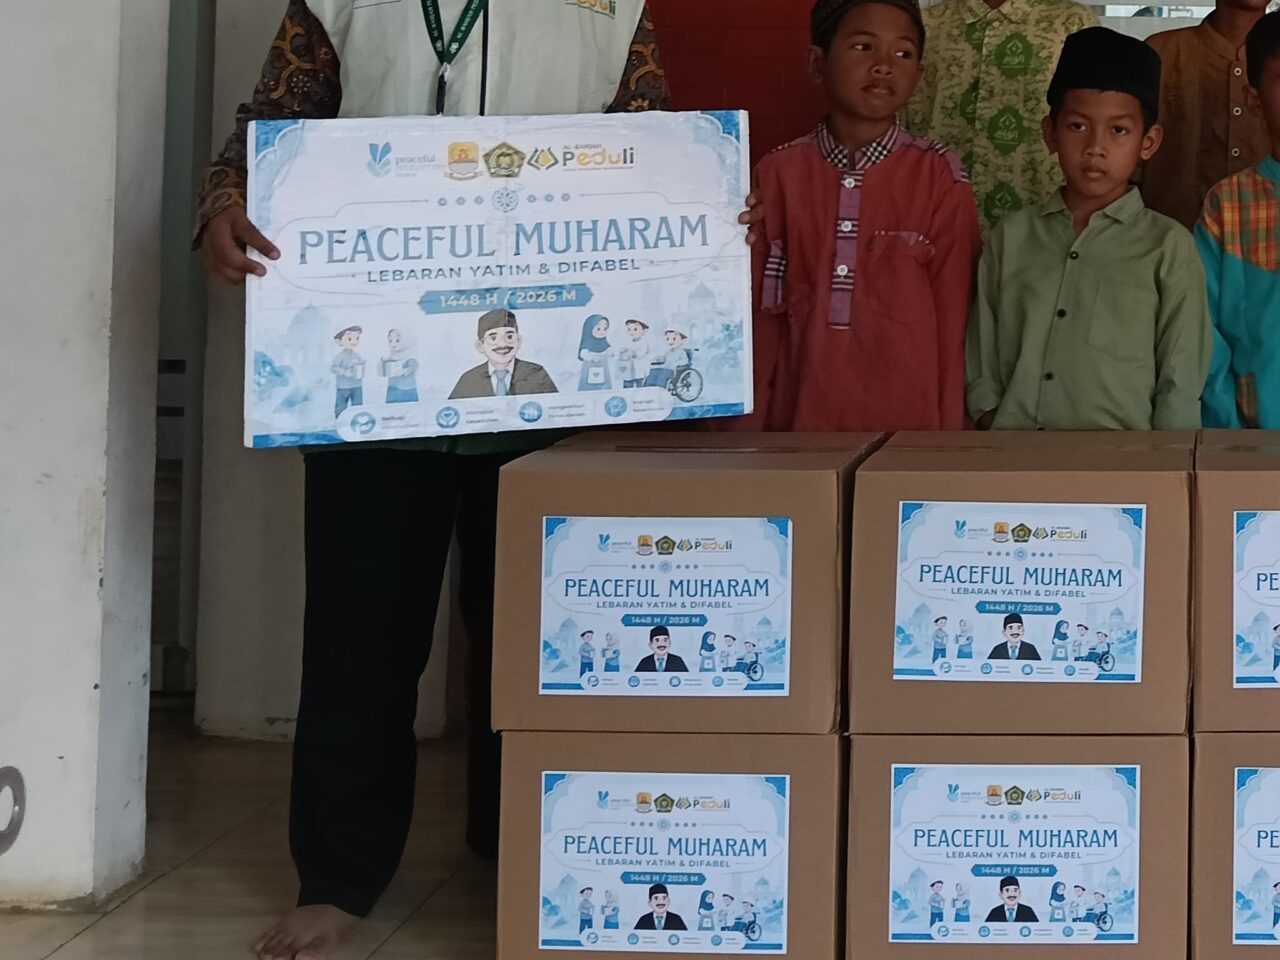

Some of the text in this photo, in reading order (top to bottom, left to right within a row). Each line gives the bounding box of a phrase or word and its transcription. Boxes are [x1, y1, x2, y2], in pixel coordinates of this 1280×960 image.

[562, 146, 634, 167] Peduli
[299, 213, 708, 266] PEACEFUL MUHARAM
[367, 257, 639, 284] LEBARAN YATIM & DIFABEL
[440, 292, 481, 308] 1448
[484, 292, 499, 306] H
[514, 288, 557, 304] 2026
[560, 288, 577, 301] M
[918, 564, 1123, 587] PEACEFUL MUHARAM
[563, 578, 769, 598] PEACEFUL MUHARAM
[950, 587, 1086, 598] LEBARAN YATIM & DIFABEL
[679, 600, 687, 608] &
[689, 600, 733, 608] DIFABEL
[985, 603, 1006, 611] 1448
[1007, 603, 1015, 611] H
[1022, 603, 1044, 612] 2026
[1045, 604, 1054, 612] M
[631, 616, 652, 624] 1448
[913, 828, 1118, 848] PEACEFUL MUHARAM
[563, 835, 767, 857] PEACEFUL MUHARAM
[595, 858, 731, 867] LEBARAN YATIM & DIFABEL
[945, 851, 1082, 859] LEBARAN YATIM & DIFABEL
[630, 873, 650, 881] 1448
[667, 874, 688, 882] 2026
[690, 874, 698, 882] M
[980, 866, 1001, 874] 1448
[1002, 866, 1010, 874] H
[1018, 866, 1039, 874] 2026
